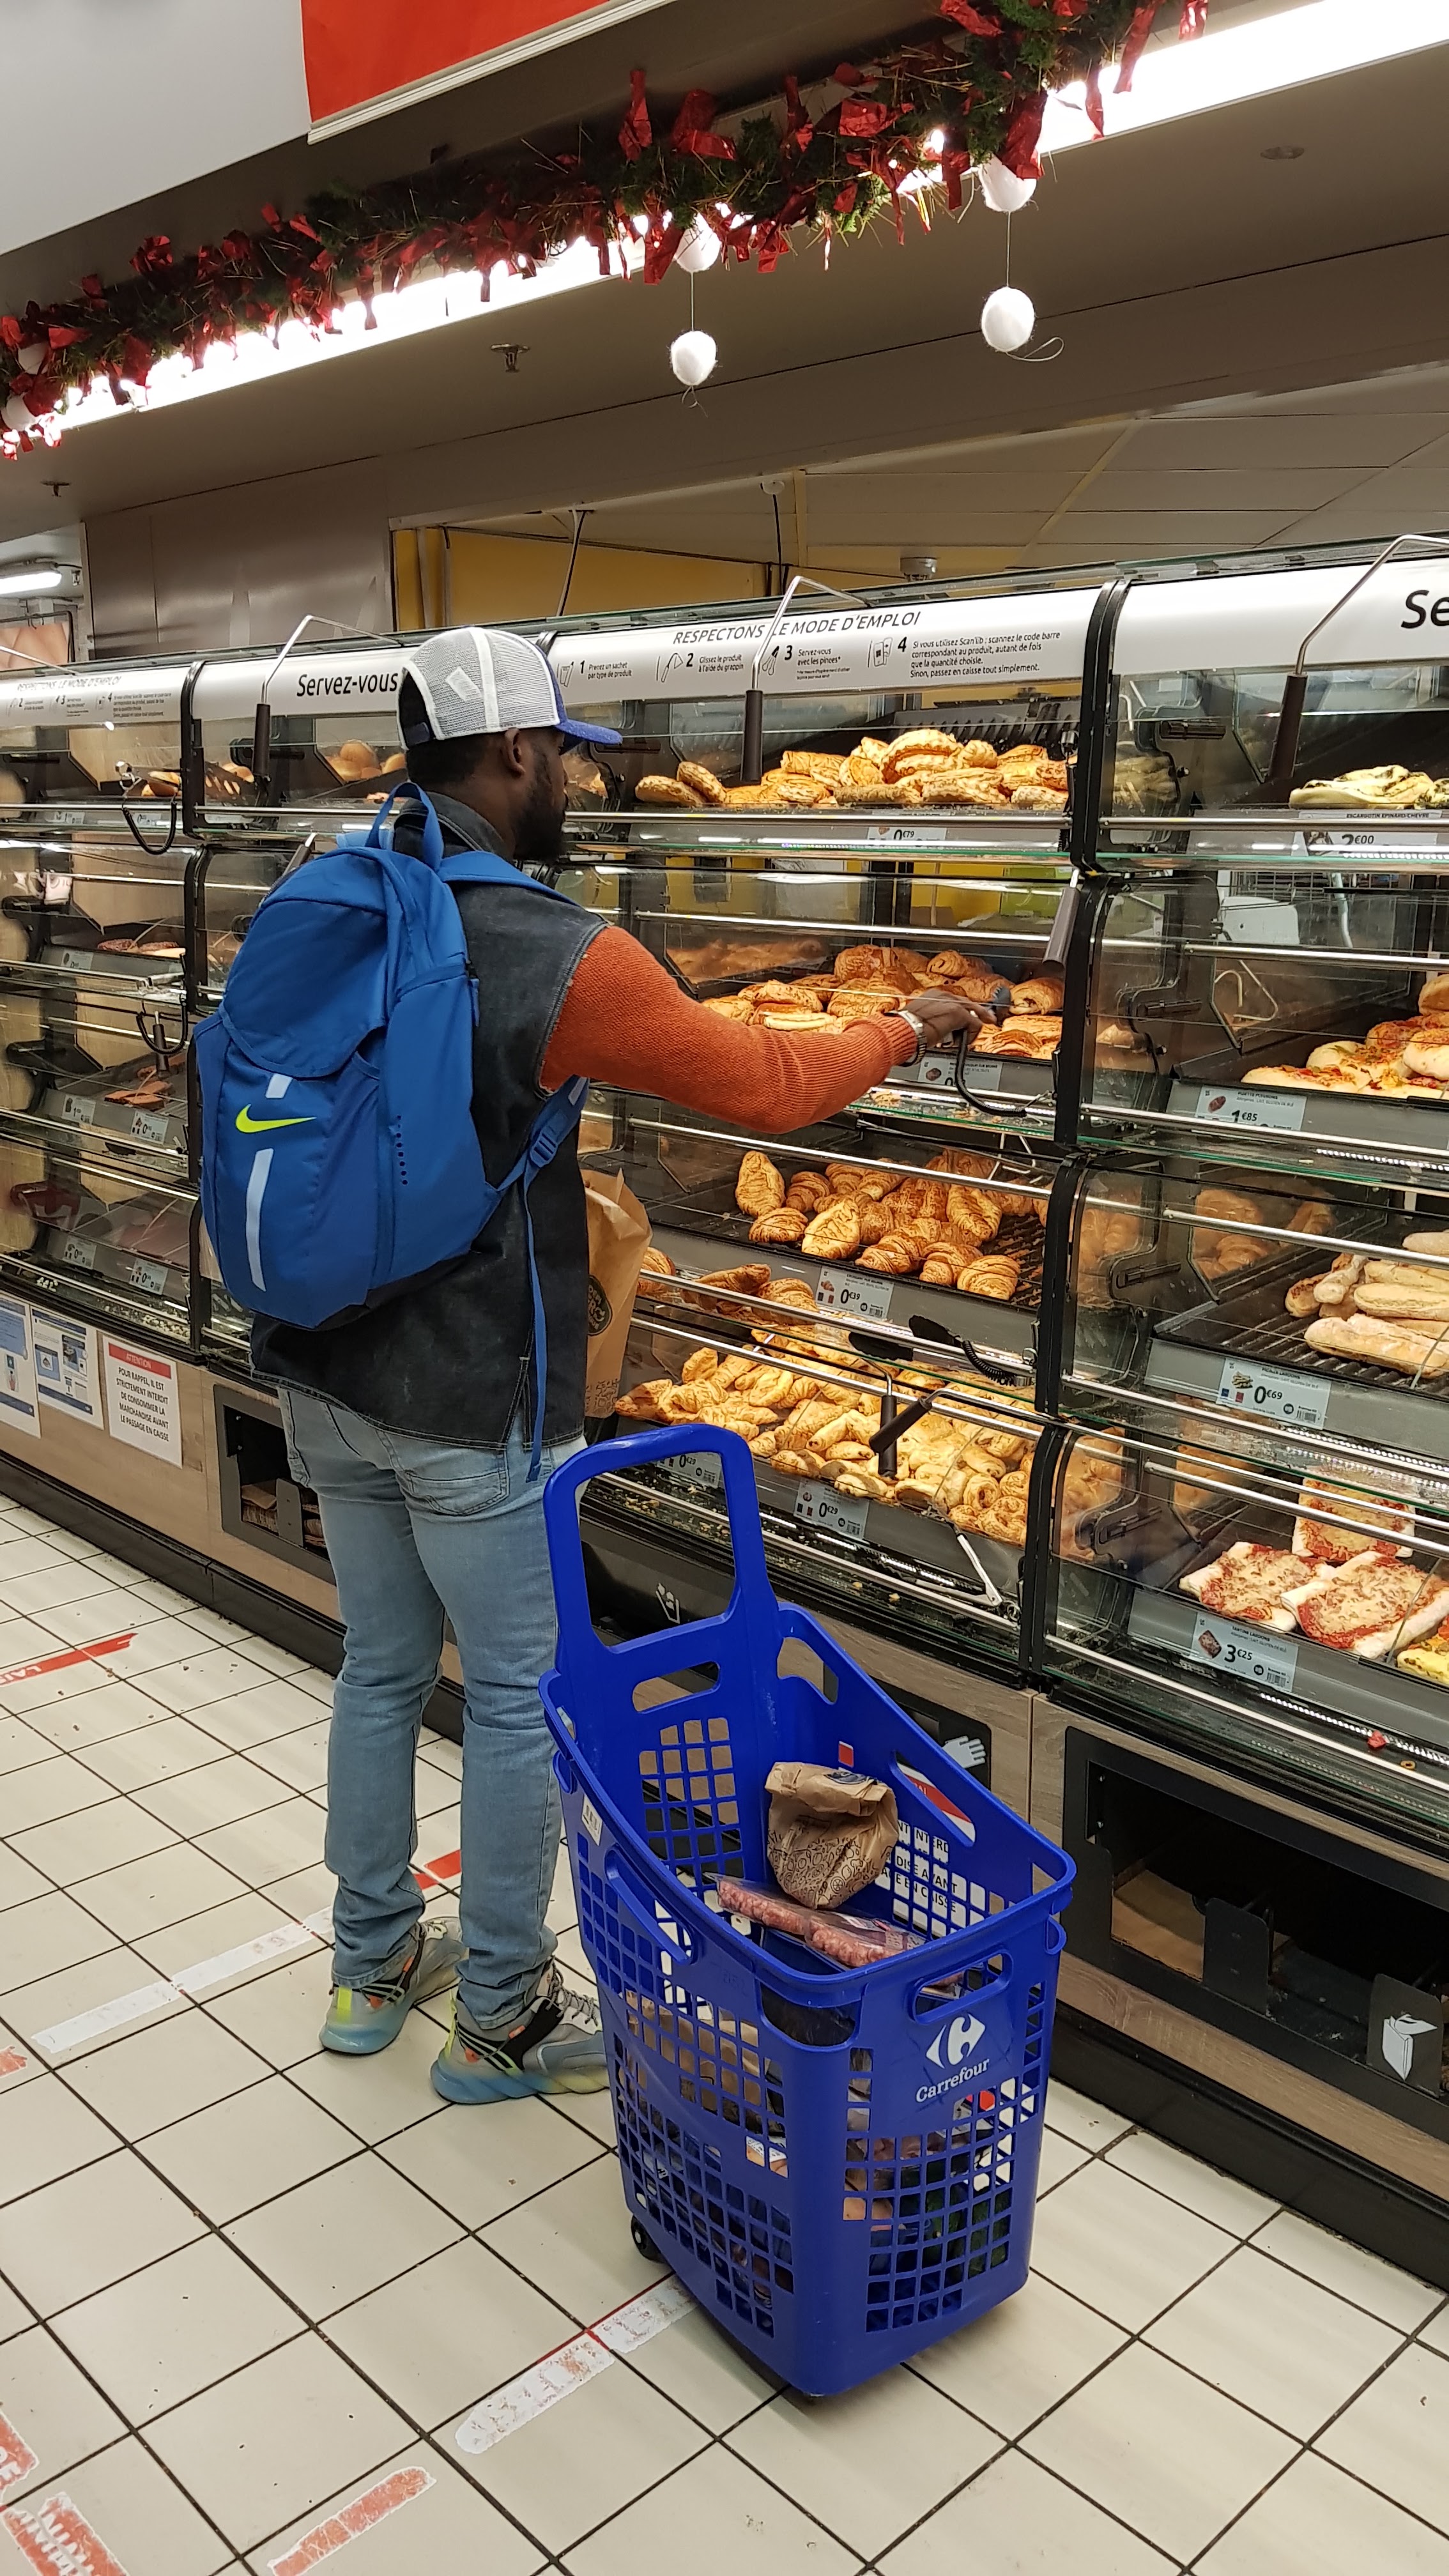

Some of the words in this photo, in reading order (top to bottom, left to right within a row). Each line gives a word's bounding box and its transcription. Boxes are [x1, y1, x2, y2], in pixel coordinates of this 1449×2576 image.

[1401, 590, 1449, 629] Se
[673, 625, 765, 644] RESPECTONS
[772, 623, 789, 636] LE
[791, 618, 839, 634] MODE
[841, 611, 921, 631] D'EMPLOI
[897, 636, 907, 652] 4
[912, 641, 919, 649] Si
[935, 638, 958, 647] utilisez
[988, 635, 1015, 644] scannez
[1023, 632, 1040, 641] code
[1041, 631, 1060, 640] barre
[723, 654, 742, 663] produit
[785, 645, 793, 661] 3
[798, 648, 831, 657] Servez-vous
[912, 648, 957, 659] correspondant
[968, 645, 994, 656] produit,
[995, 644, 1017, 653] autant
[1018, 643, 1027, 652] de
[1029, 642, 1041, 650] fois
[580, 660, 585, 674] 1
[686, 652, 694, 668] 2
[911, 661, 923, 670] que
[931, 657, 958, 668] quantité
[959, 657, 983, 665] choisie.
[613, 670, 632, 678] produit
[910, 670, 929, 678] Sinon,
[930, 669, 951, 678] passez
[983, 666, 997, 674] tout
[998, 663, 1040, 673] simplement.
[296, 673, 398, 697] Servez-vous
[126, 1353, 151, 1369] ATTENTION
[118, 1367, 131, 1377] POUR
[156, 1382, 164, 1391] EST
[116, 1378, 146, 1397] STRICTEMENT
[147, 1390, 169, 1405] INTERDIT
[121, 1392, 127, 1400] DE
[128, 1394, 158, 1413] CONSOMMER
[159, 1407, 165, 1416] LA
[119, 1403, 152, 1423] MARCHANDISE
[153, 1417, 169, 1429] AVANT
[126, 1417, 145, 1432] PASSAGE
[146, 1425, 153, 1435] EN
[153, 1429, 169, 1441] CAISSE
[916, 2058, 990, 2103] Carrefour
